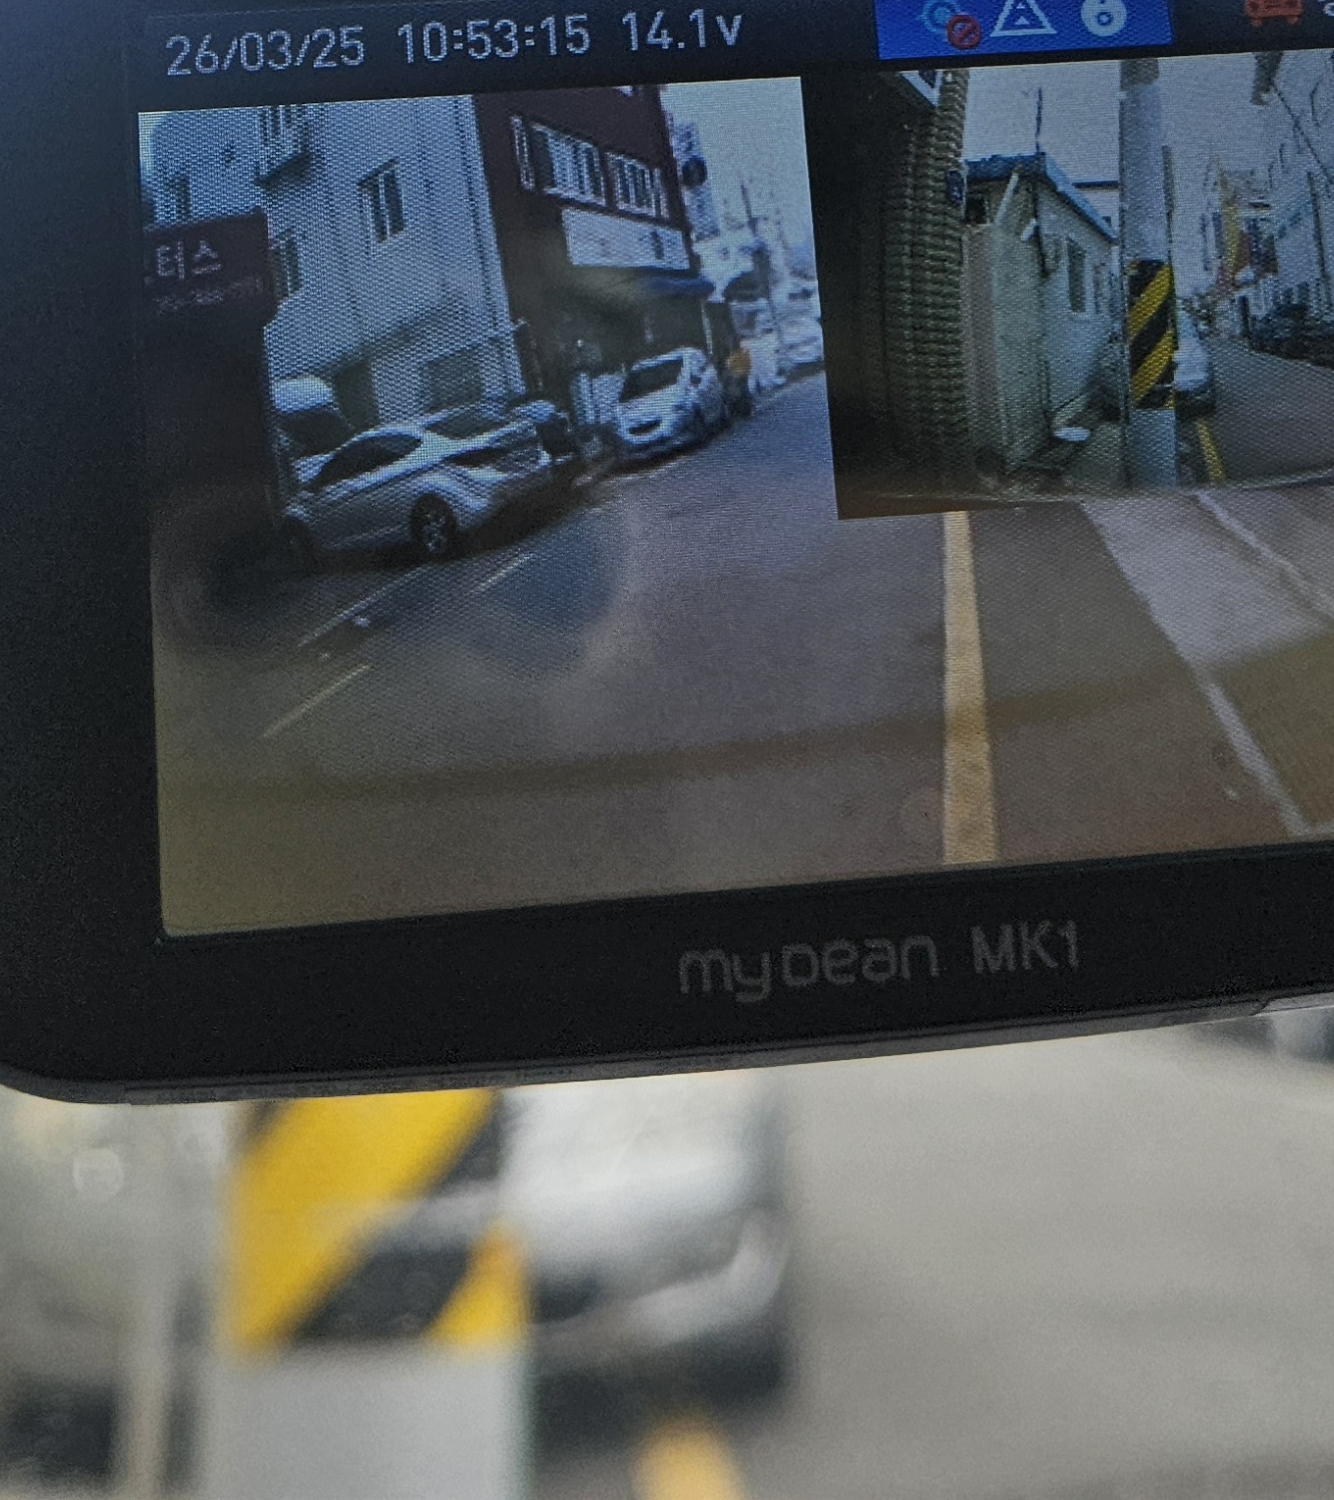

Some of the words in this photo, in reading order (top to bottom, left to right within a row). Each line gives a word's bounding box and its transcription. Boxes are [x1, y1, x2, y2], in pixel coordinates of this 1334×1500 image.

[165, 25, 366, 77] 26/03/25
[397, 12, 592, 65] 10:53:15
[970, 919, 1080, 975] MK1
